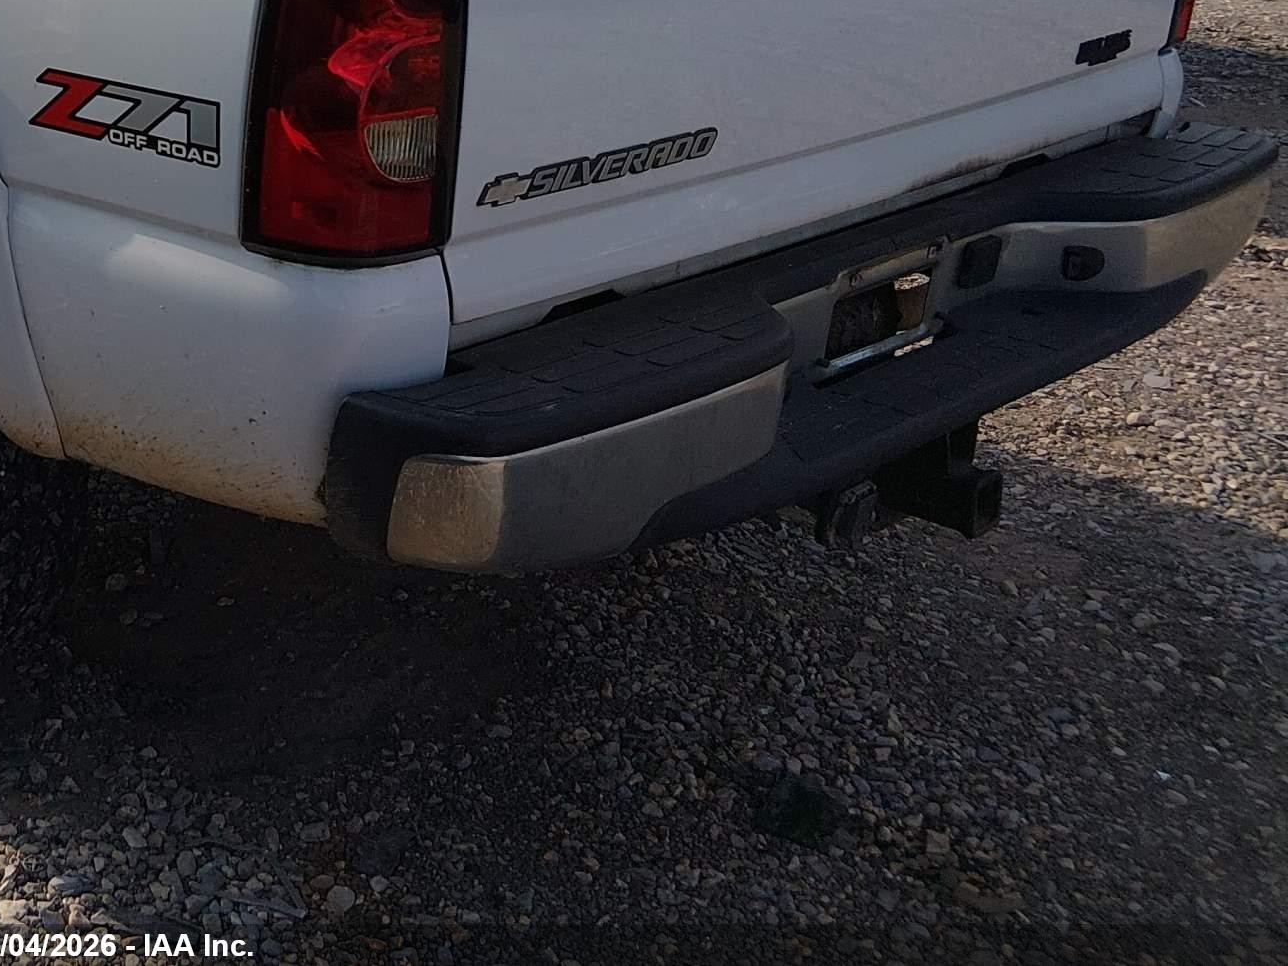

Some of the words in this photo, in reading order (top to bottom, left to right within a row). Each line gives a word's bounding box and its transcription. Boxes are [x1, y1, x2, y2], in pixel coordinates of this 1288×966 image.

[29, 68, 220, 150] Z71
[109, 129, 148, 150] OFF
[157, 140, 220, 166] ROAD
[527, 128, 718, 198] SILVERADO
